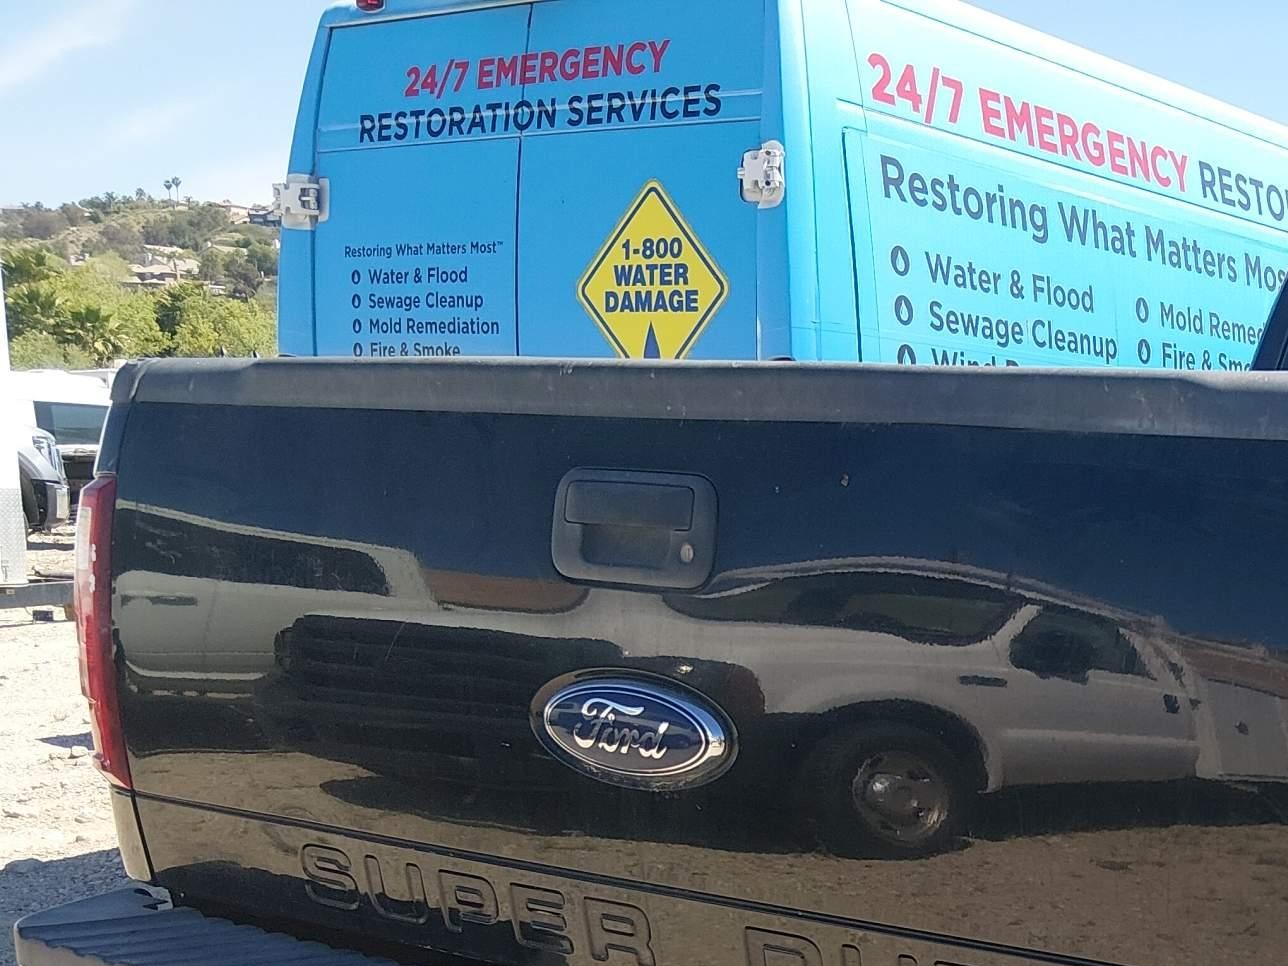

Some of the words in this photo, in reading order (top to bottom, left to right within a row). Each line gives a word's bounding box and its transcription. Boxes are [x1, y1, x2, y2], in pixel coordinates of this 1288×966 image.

[404, 59, 469, 99] 24/7
[476, 40, 670, 90] EMERGENCY
[359, 98, 557, 143] RESTORATION
[567, 84, 721, 125] SERVICES
[867, 53, 963, 124] 24/7
[979, 88, 1187, 193] EMERGENCY
[880, 154, 1049, 244] Restoring
[1058, 202, 1137, 258] What
[1146, 225, 1237, 282] Matters
[344, 245, 392, 259] Restoring
[395, 244, 424, 256] What
[426, 242, 467, 256] Matters
[622, 237, 683, 260] 1-800
[368, 269, 409, 285] Water
[413, 268, 422, 283] &
[427, 266, 468, 283] Flood
[614, 263, 689, 286] WATER
[925, 251, 1001, 295] Water
[1009, 269, 1025, 300] &
[1032, 273, 1095, 313] Flood
[368, 293, 420, 311] Sewage
[425, 292, 484, 311] Cleanup
[604, 290, 699, 312] DAMAGE
[369, 318, 401, 334] Mold
[406, 317, 499, 335] Remediation
[1160, 302, 1203, 335] Mold
[929, 301, 1024, 348] Sewage
[1031, 319, 1117, 364] Cleanup
[370, 342, 396, 357] Fire
[401, 343, 409, 357] &
[413, 342, 460, 357] Smoke
[1162, 343, 1195, 370] Fire
[573, 698, 669, 760] Ford
